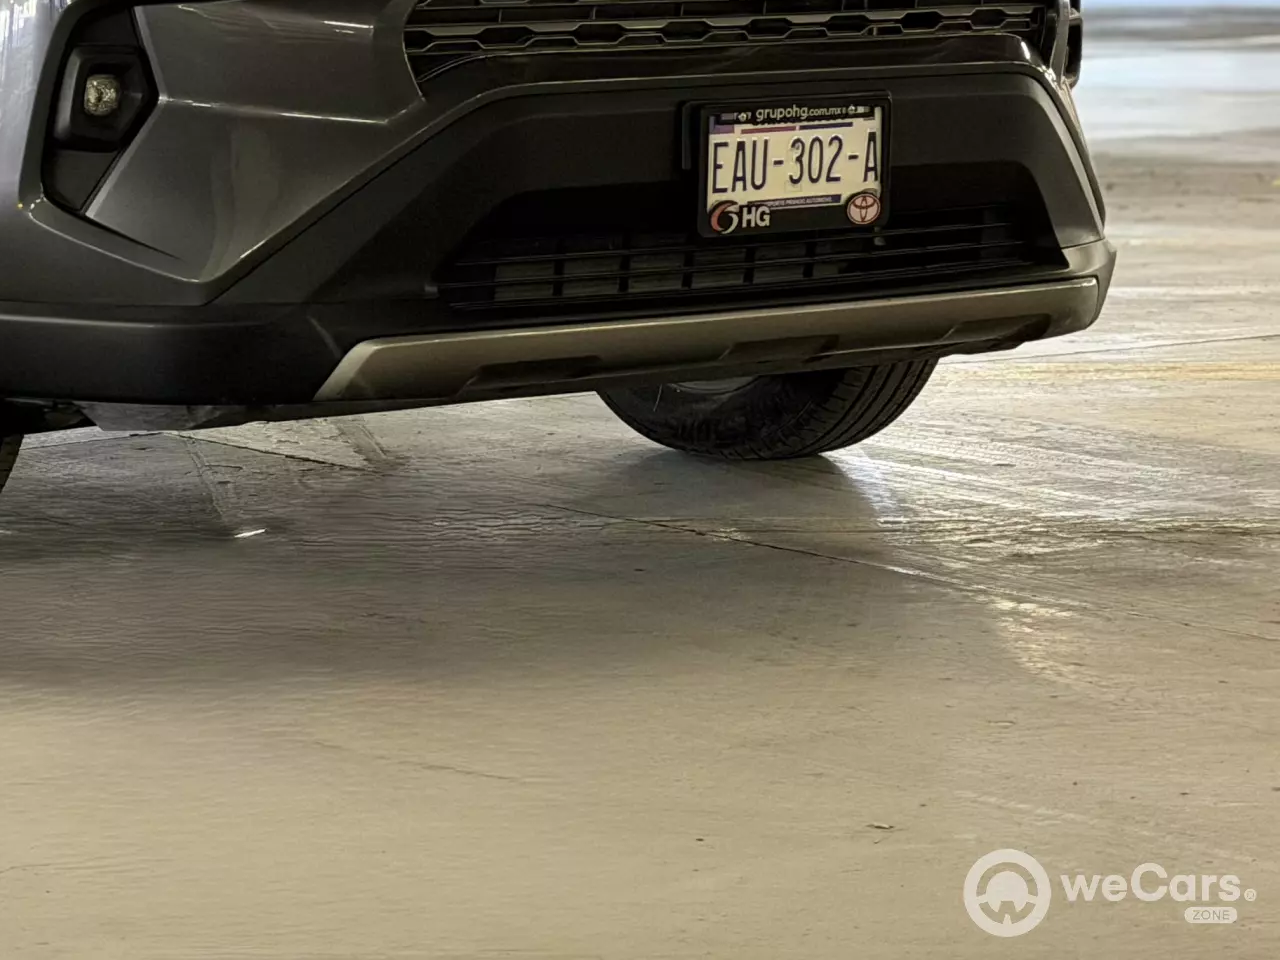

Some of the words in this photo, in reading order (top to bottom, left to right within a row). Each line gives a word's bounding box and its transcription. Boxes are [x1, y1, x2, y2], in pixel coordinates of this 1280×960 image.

[756, 104, 842, 121] grupohg.com.mx
[712, 131, 878, 193] EAU-302-A
[741, 207, 770, 228] HG
